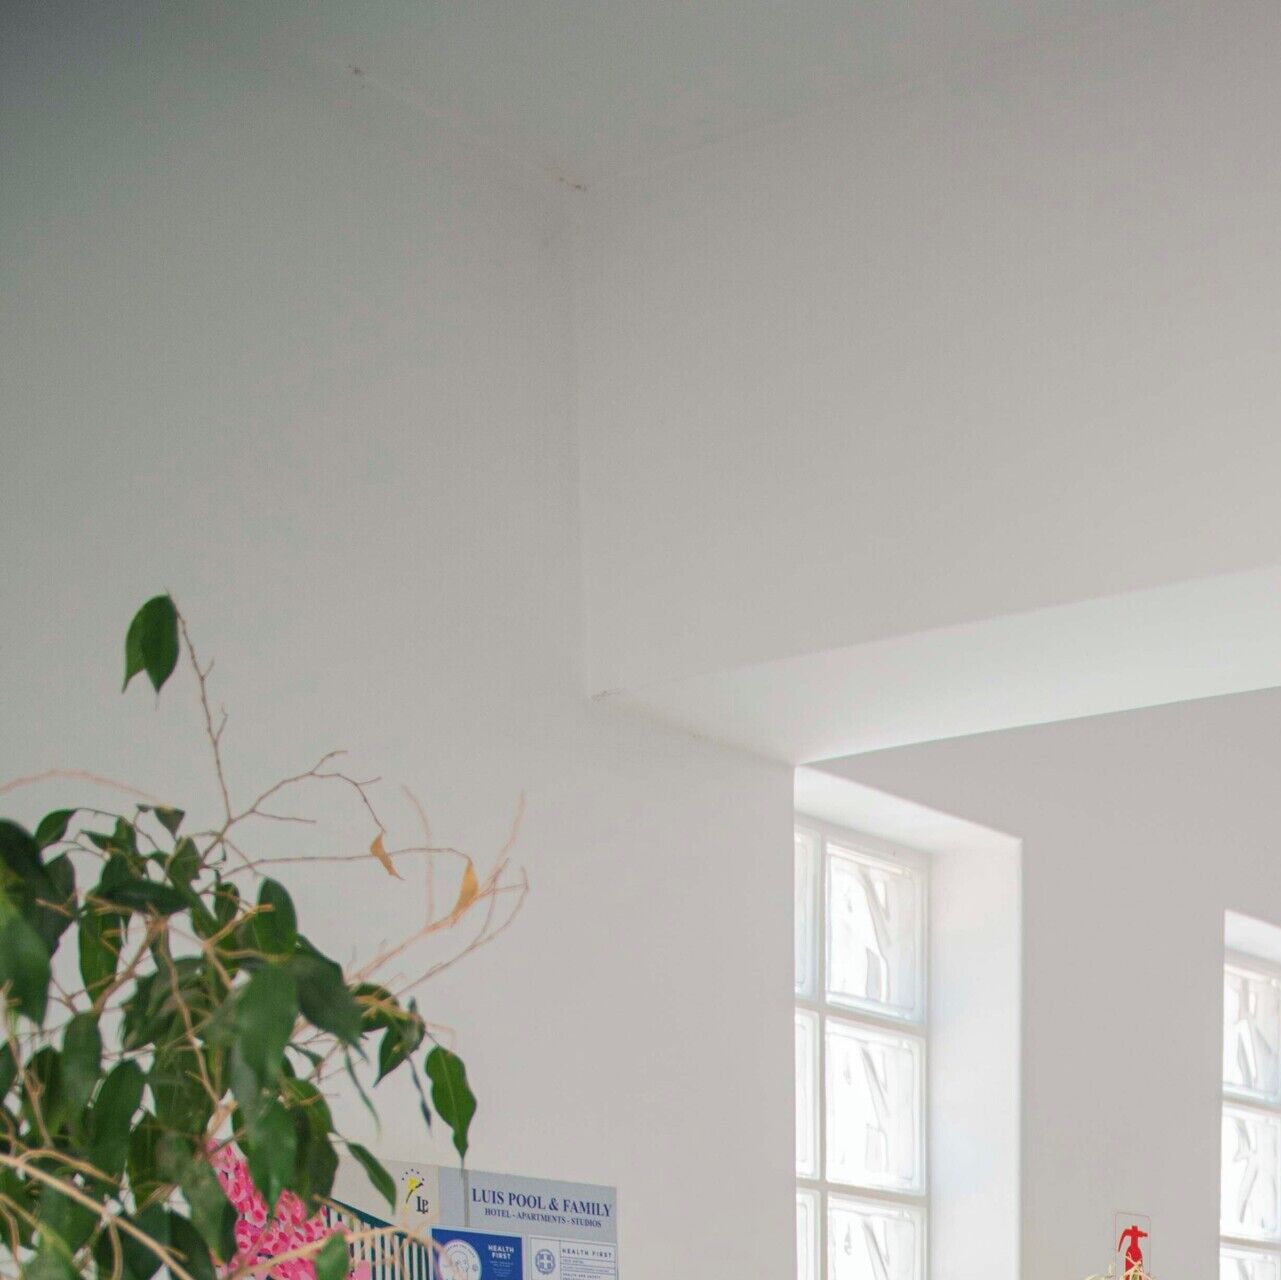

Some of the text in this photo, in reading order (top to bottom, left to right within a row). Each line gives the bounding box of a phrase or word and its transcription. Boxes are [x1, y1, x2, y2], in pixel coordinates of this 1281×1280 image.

[472, 1188, 612, 1217] LUIS POOL & FAMILY
[485, 1208, 601, 1228] HOTEL APARTMENTS STUDIOS
[488, 1244, 514, 1252] HEALTH
